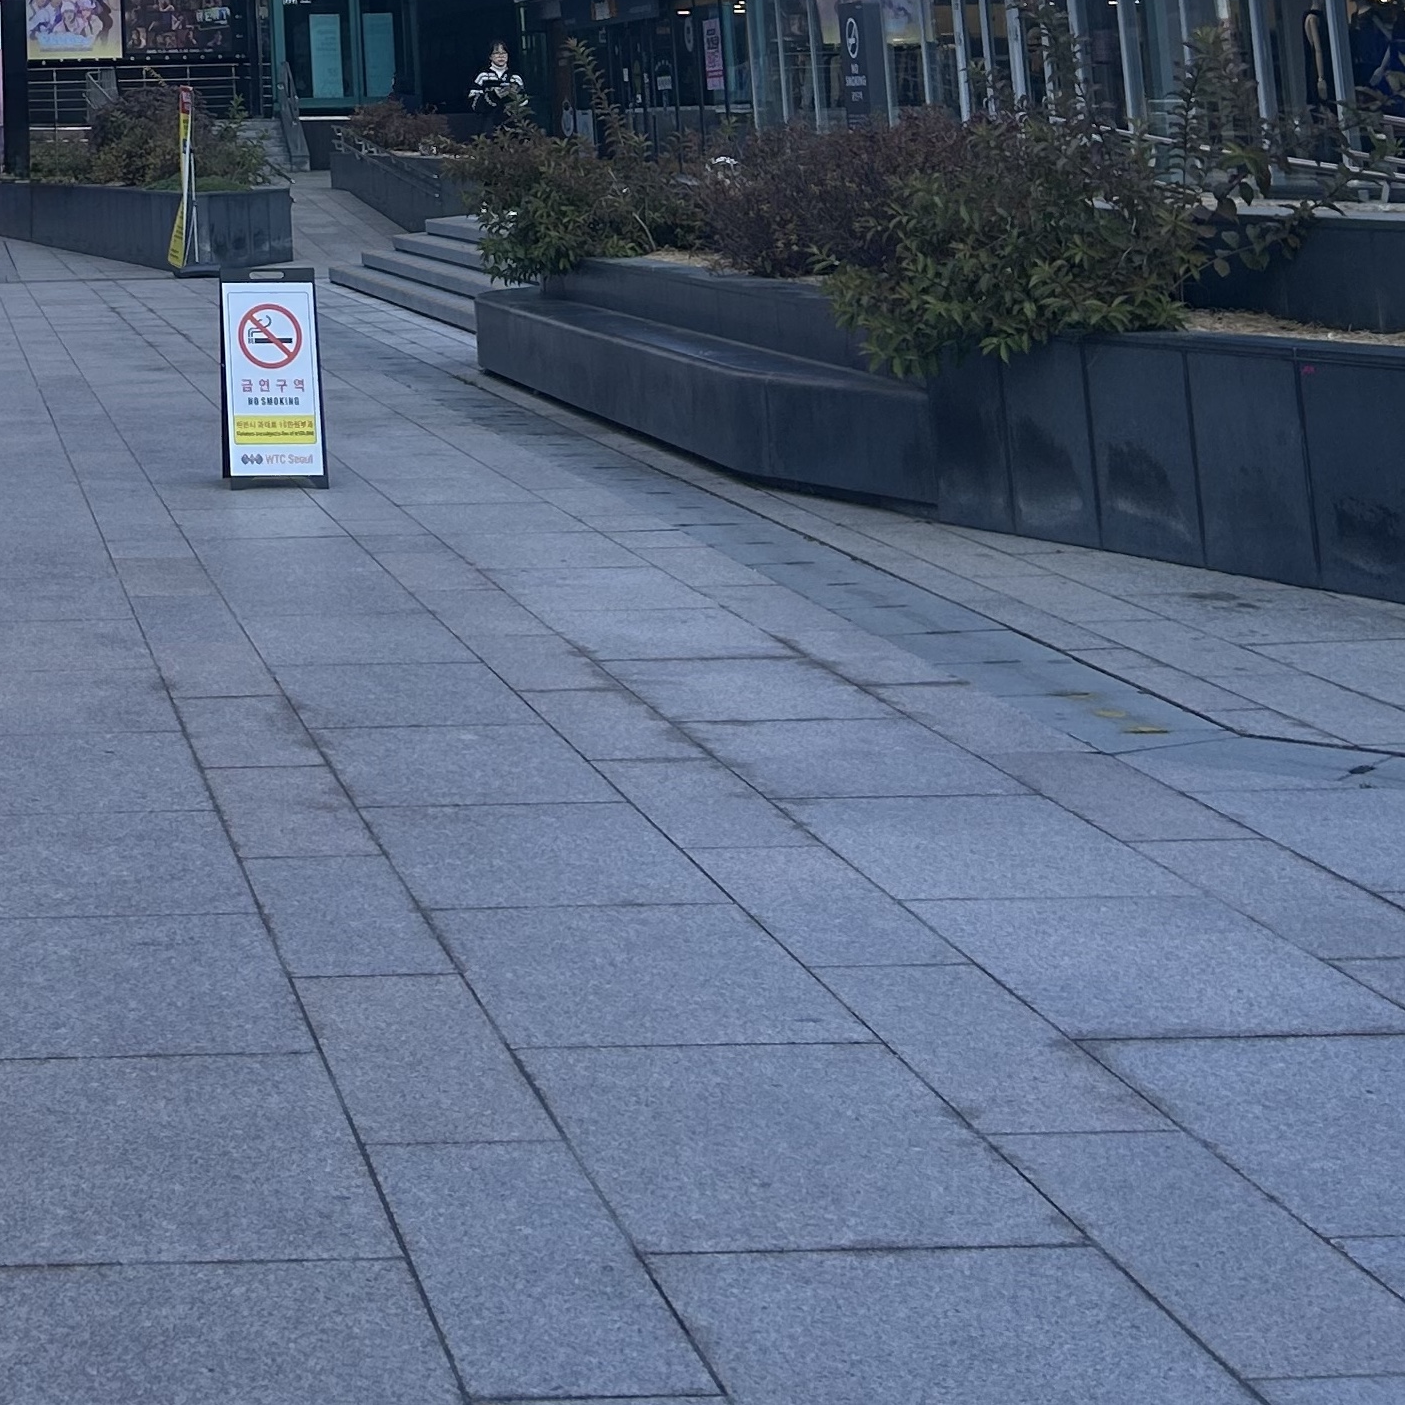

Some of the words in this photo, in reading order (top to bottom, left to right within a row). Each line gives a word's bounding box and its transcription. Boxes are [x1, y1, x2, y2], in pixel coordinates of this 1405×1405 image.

[241, 378, 305, 393] 금연구역
[248, 397, 259, 406] NO
[261, 397, 300, 406] SMOKING
[265, 454, 286, 464] WTC
[288, 453, 313, 464] Seoul
